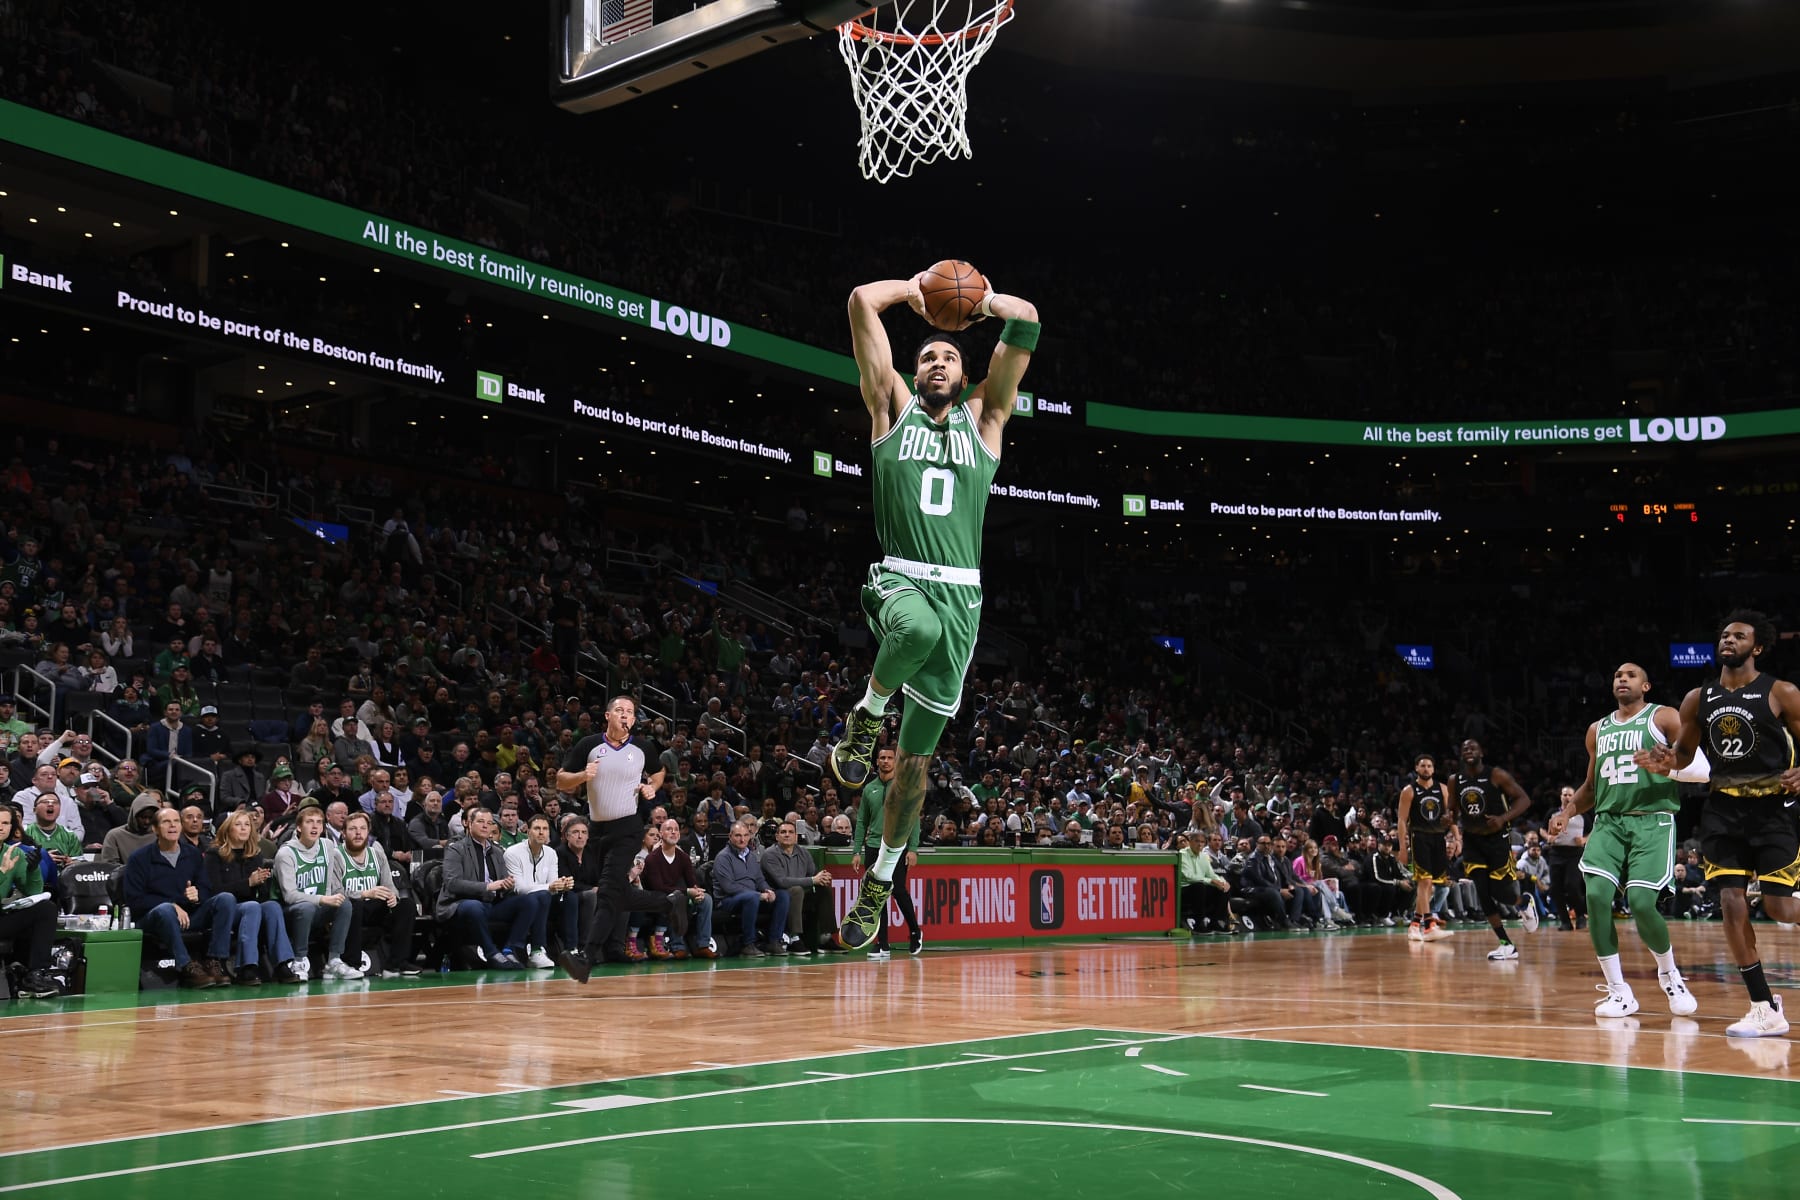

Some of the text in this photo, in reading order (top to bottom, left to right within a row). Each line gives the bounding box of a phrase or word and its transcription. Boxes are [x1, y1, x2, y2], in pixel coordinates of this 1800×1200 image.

[12, 263, 72, 293] Bank
[363, 221, 731, 347] All the best family reunions get LOUD
[117, 290, 445, 383] Proud to be part of the Boston fan family.
[480, 375, 545, 403] TD Bank
[1038, 399, 1072, 415] Bank
[574, 400, 792, 464] Proud to be part of the Boston fan family.
[1363, 416, 1727, 443] All the best family reunions get LOUD
[898, 425, 976, 469] BOSTON
[815, 456, 862, 477] TD Bank
[920, 467, 955, 516] 0
[990, 483, 1100, 509] the Boston fan family.
[1125, 498, 1184, 513] TD Bank
[1210, 502, 1442, 522] Proud to be part of the Boston fan family.
[1616, 513, 1624, 523] 9
[1643, 504, 1668, 515] 8:54
[1691, 512, 1699, 522] 6
[1597, 730, 1643, 757] BOSTON
[1721, 738, 1744, 757] 22
[1600, 754, 1639, 786] 42
[1467, 803, 1480, 815] 23
[74, 871, 110, 882] @celti
[832, 879, 862, 929] TH
[910, 877, 1016, 926] HAPPENING
[1077, 876, 1168, 921] GET THE APP
